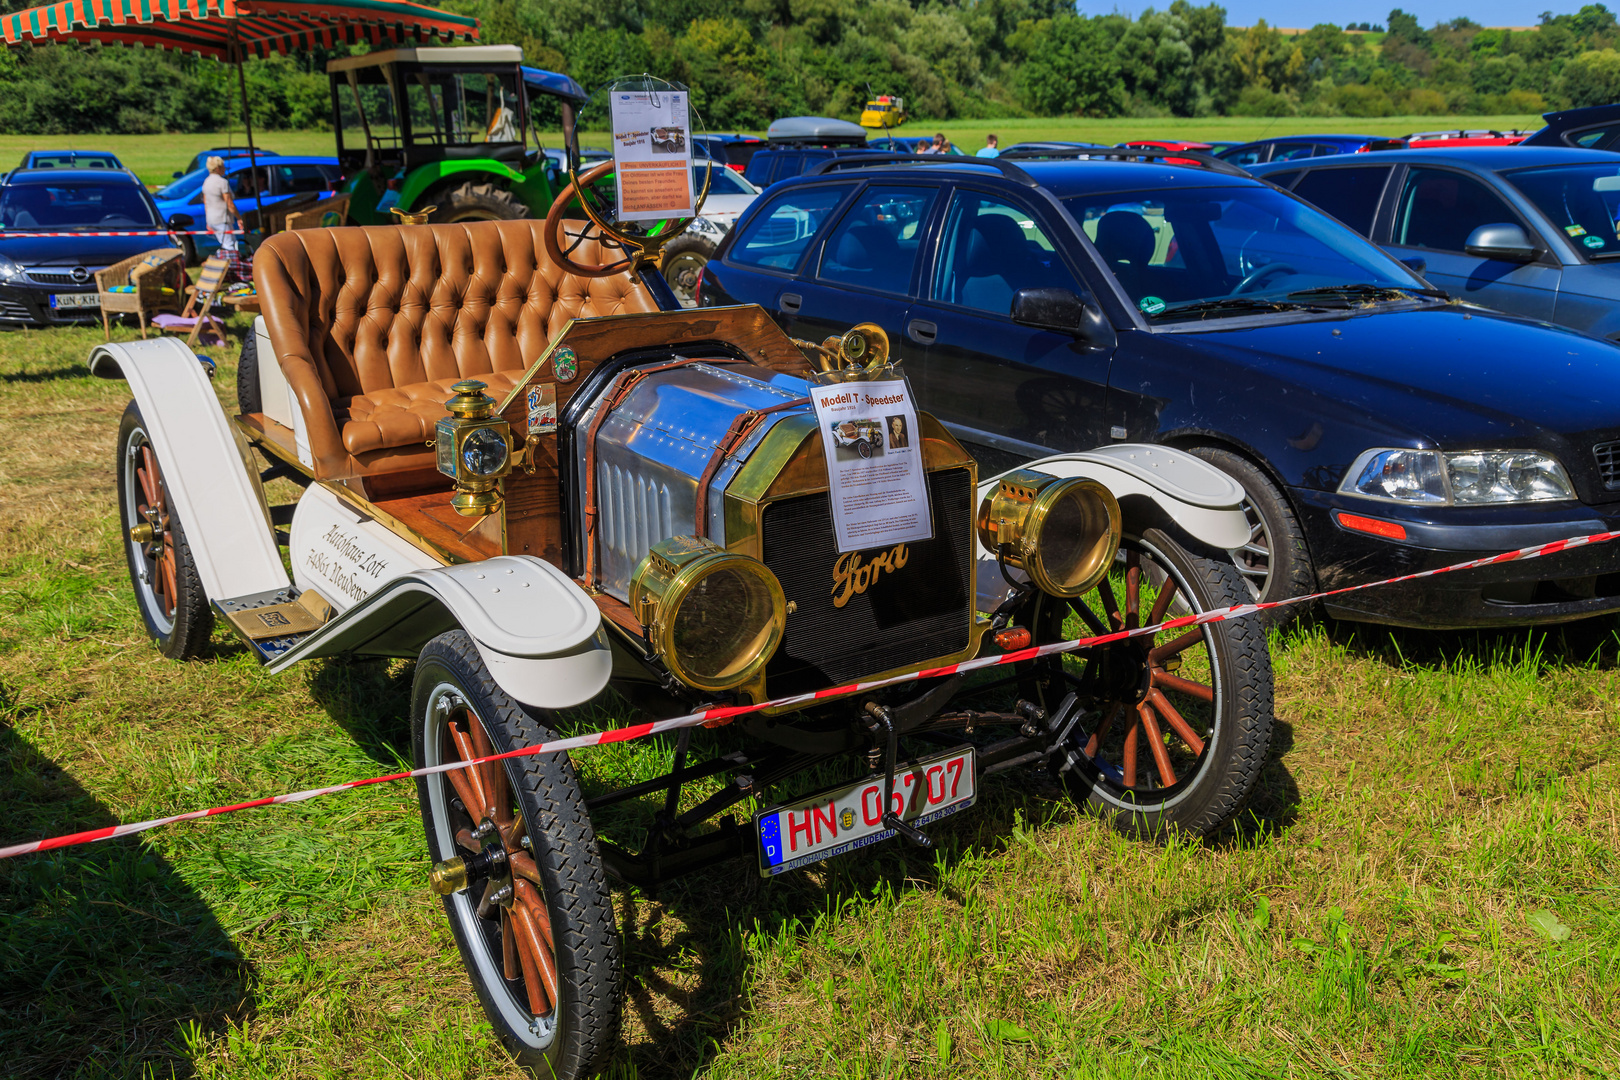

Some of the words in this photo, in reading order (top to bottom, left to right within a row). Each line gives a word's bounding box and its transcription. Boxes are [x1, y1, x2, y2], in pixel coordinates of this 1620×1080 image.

[82, 295, 96, 304] KH
[821, 392, 852, 408] Modell
[853, 393, 859, 403] T
[865, 394, 904, 407] Speedster
[306, 548, 330, 577] 74861
[329, 561, 369, 602] Neudena
[322, 524, 365, 564] Autohaus
[358, 553, 389, 579] Lott
[831, 544, 909, 608] Ford
[768, 845, 775, 857] D
[788, 798, 838, 852] HN
[788, 850, 829, 870] AUTOHAUS
[832, 843, 850, 856] LOTT
[852, 829, 895, 850] NEUDENAU
[944, 805, 956, 816] 300
